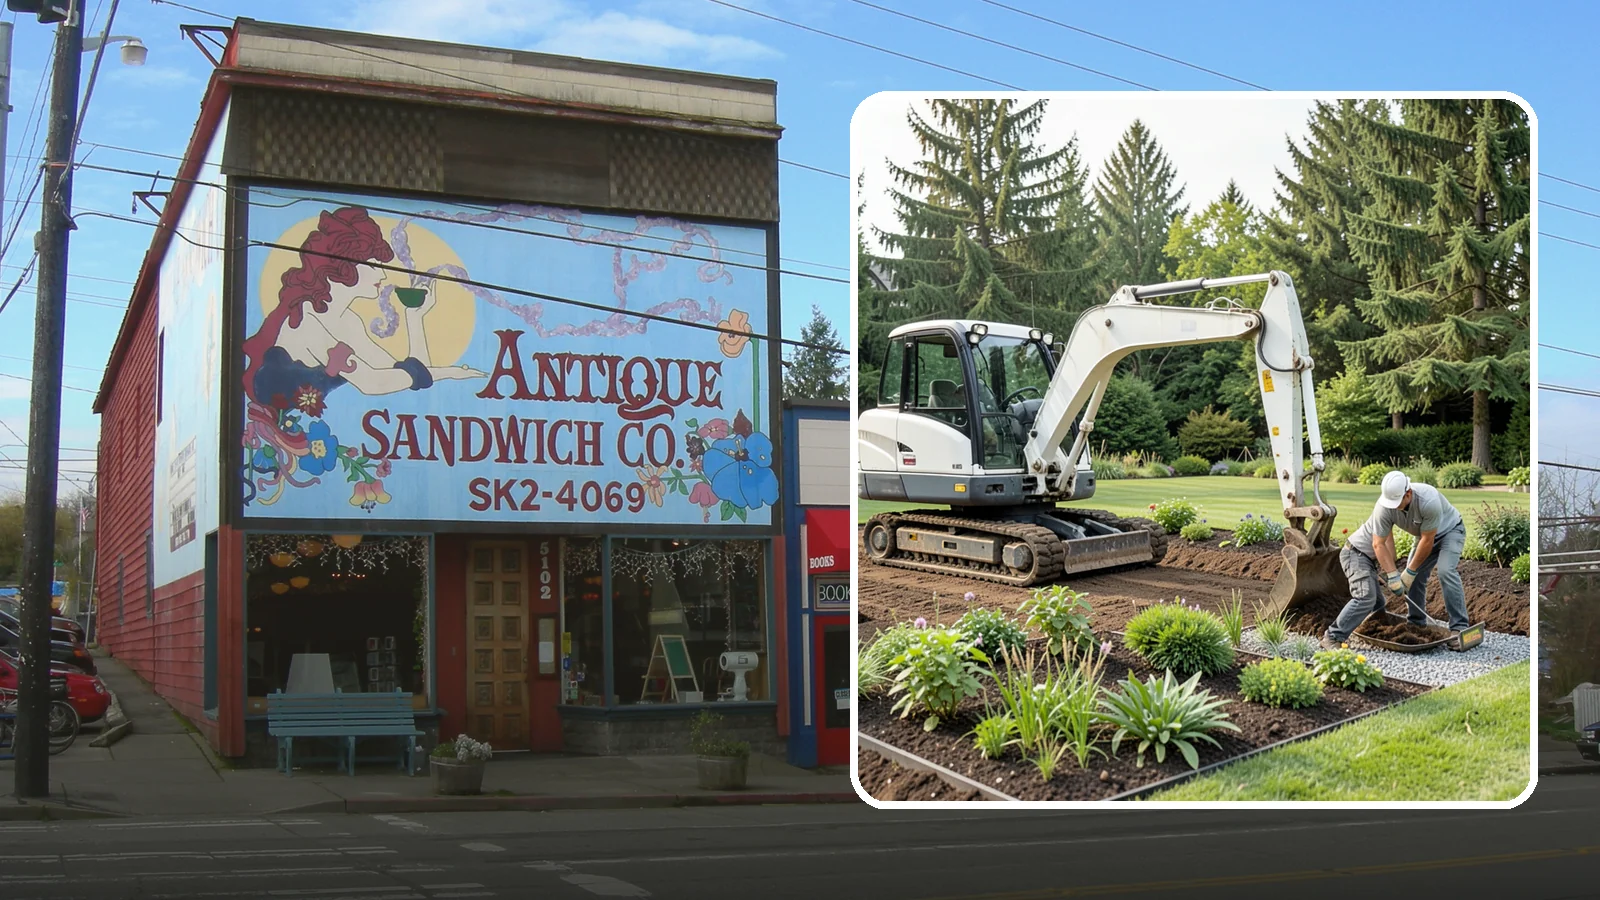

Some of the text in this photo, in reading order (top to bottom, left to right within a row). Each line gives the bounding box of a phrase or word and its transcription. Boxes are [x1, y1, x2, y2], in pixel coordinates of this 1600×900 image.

[475, 328, 724, 421] ANTIQUE
[361, 408, 685, 470] SANDWICH CO.
[468, 477, 646, 513] SK2-4069
[539, 541, 552, 599] 5102
[809, 555, 835, 569] BOOKS
